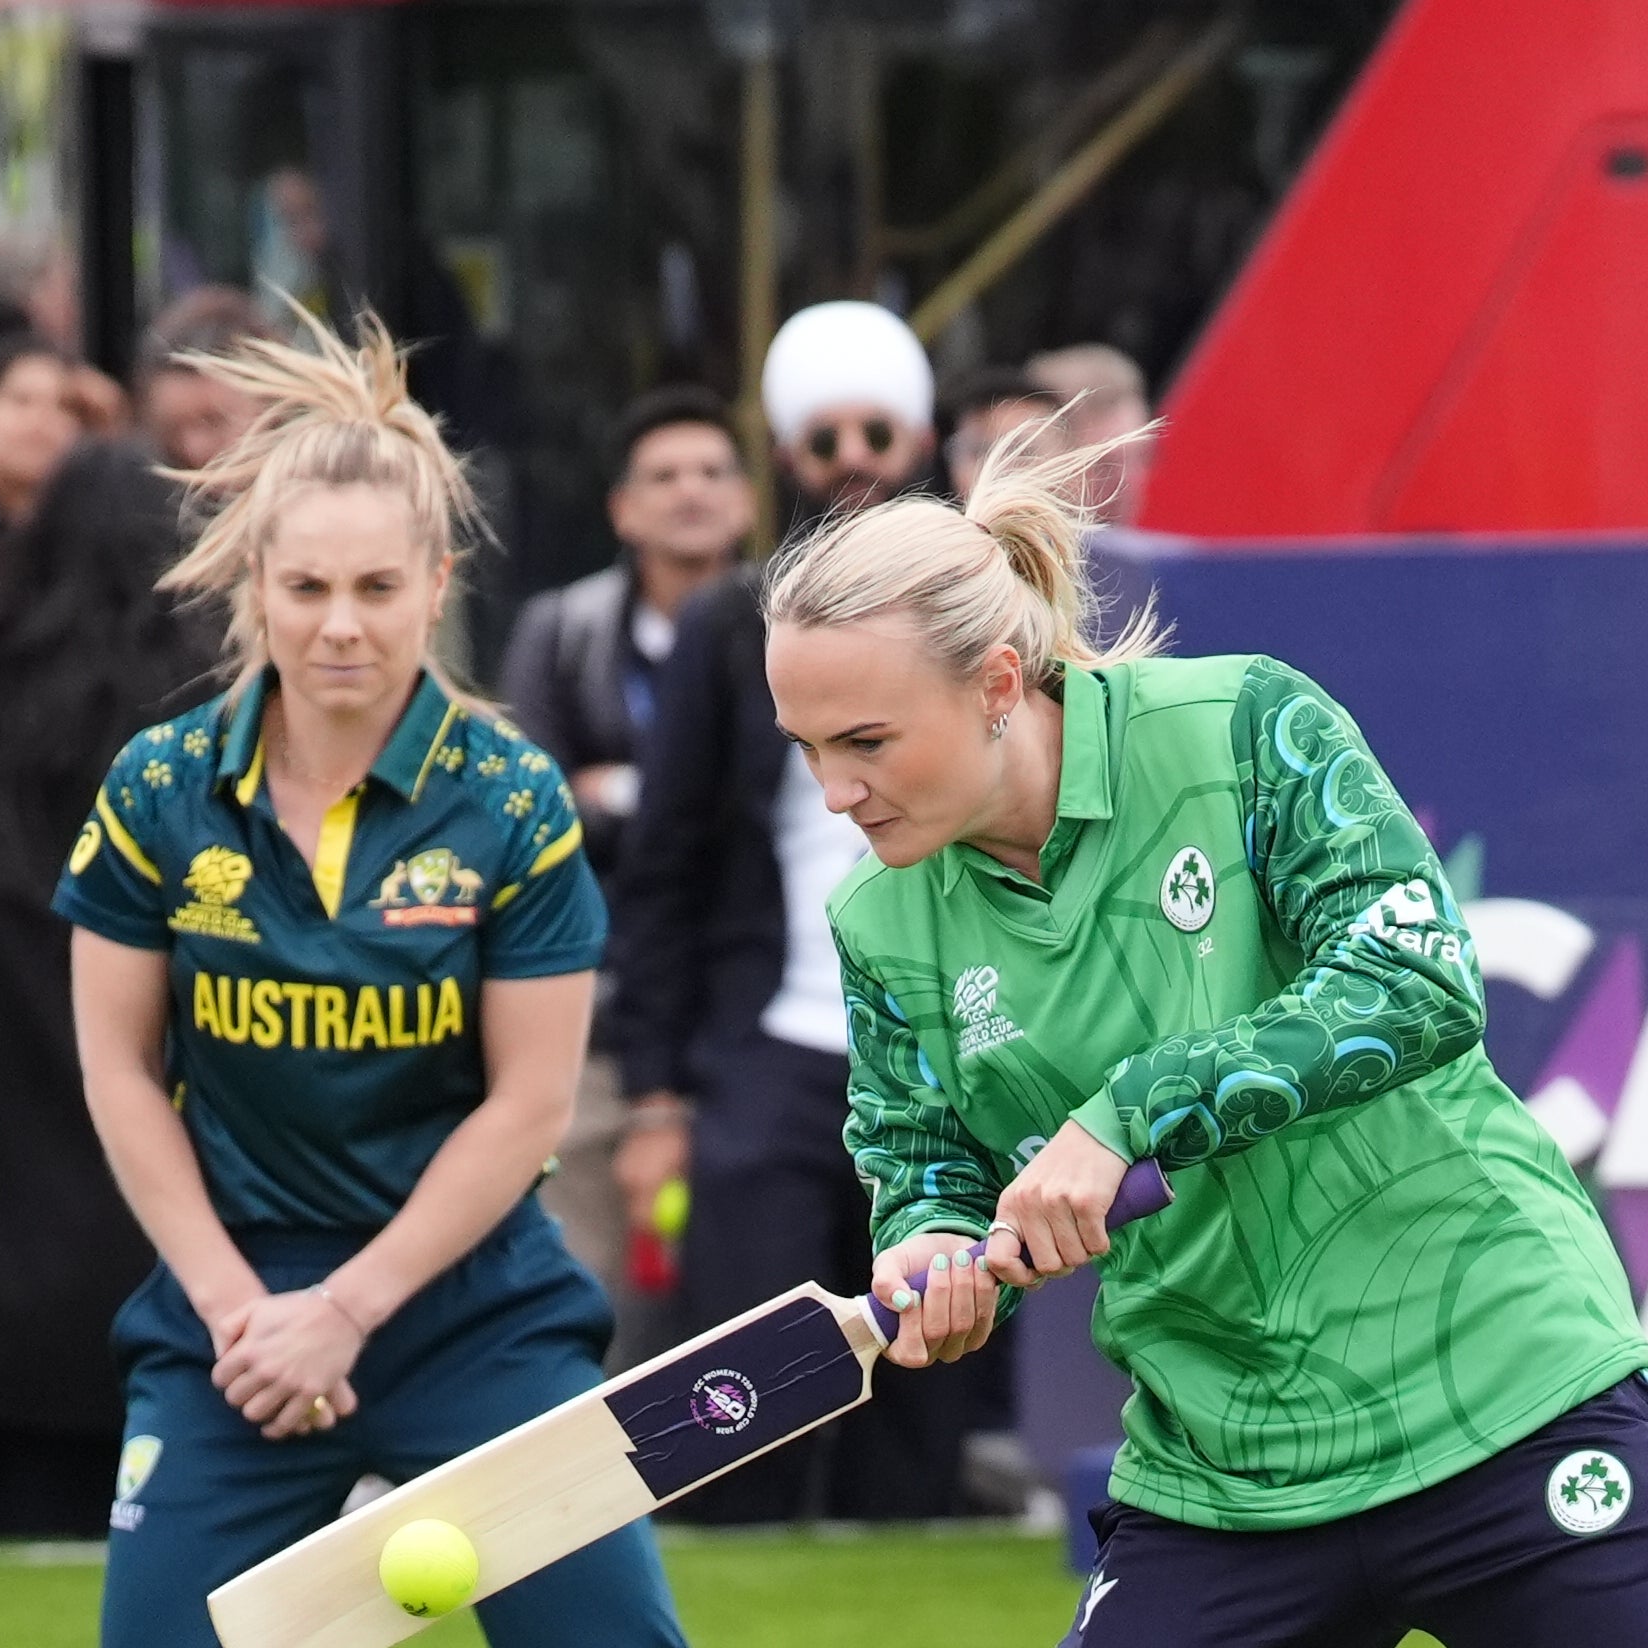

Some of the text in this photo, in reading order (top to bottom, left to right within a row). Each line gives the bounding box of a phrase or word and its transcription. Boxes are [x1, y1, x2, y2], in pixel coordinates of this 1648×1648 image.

[1197, 936, 1214, 957] 32
[1348, 921, 1461, 962] vara
[194, 971, 463, 1050] AUSTRALIA
[968, 1009, 987, 1024] ICC
[991, 1020, 1014, 1036] CUP
[693, 1368, 758, 1435] ICC WOMEN'S T20 WORLD CUP 2026
